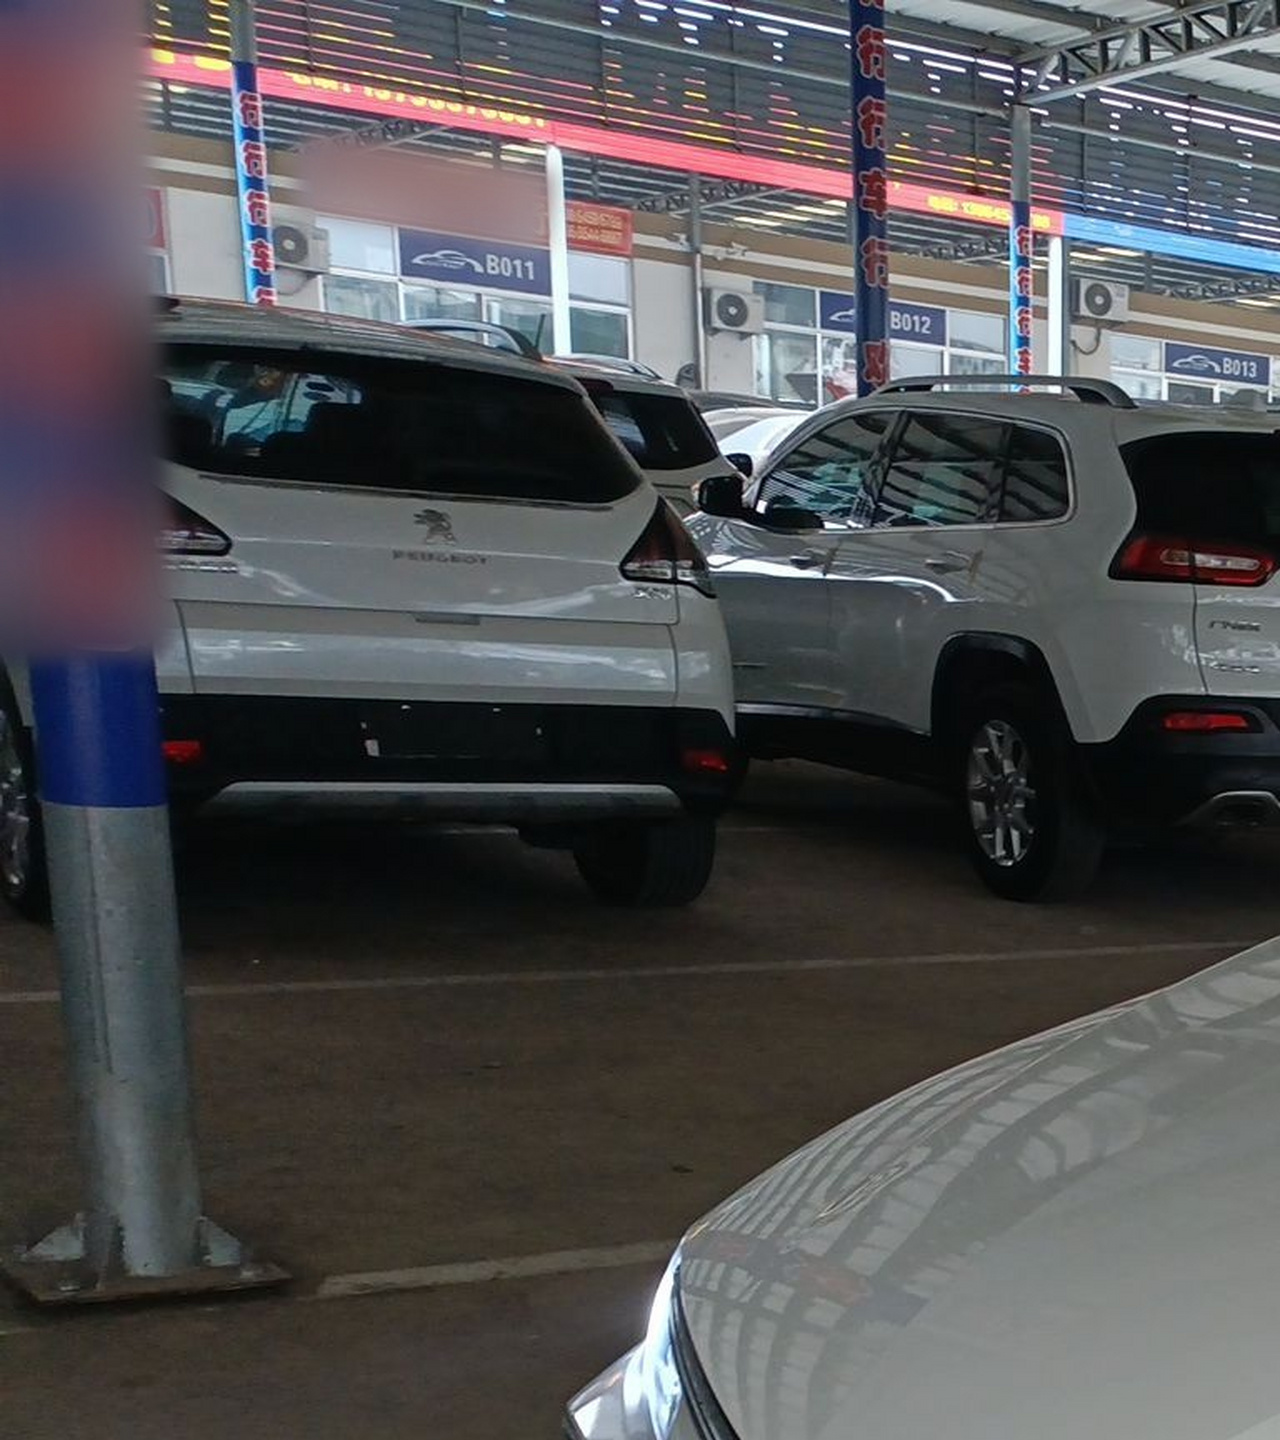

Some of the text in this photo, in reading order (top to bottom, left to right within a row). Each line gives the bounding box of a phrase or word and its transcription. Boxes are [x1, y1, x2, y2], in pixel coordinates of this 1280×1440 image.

[486, 253, 535, 281] B011
[889, 310, 933, 335] B012
[1222, 356, 1258, 379] B013
